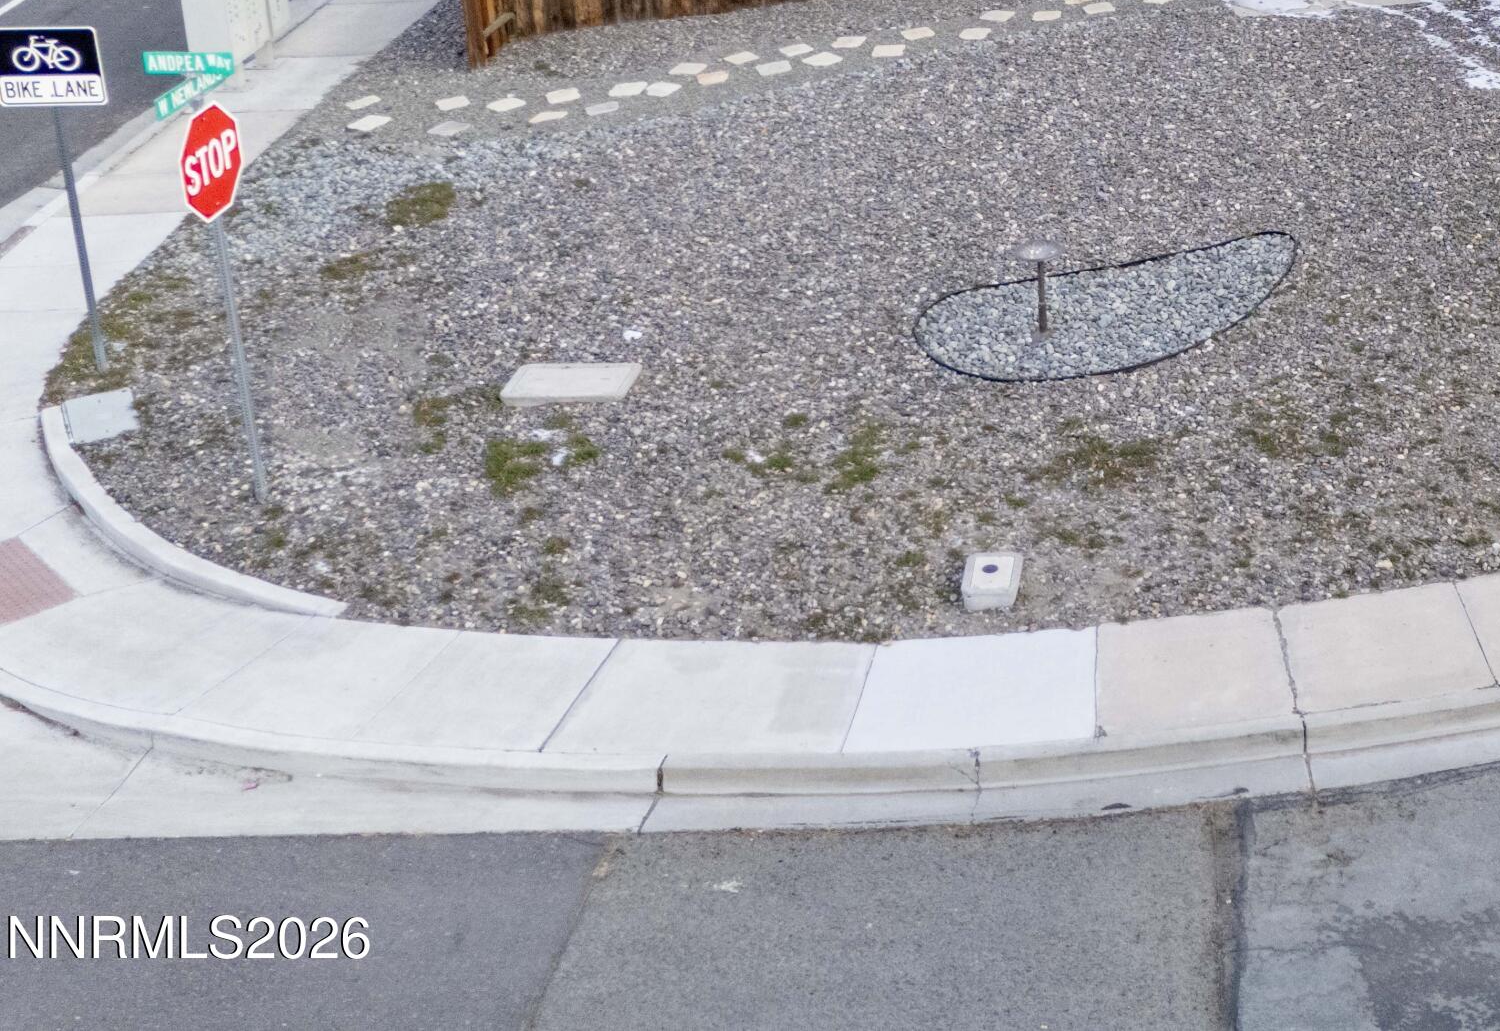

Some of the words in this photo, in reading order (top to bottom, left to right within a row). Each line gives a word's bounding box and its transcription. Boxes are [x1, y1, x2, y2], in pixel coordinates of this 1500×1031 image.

[147, 54, 205, 72] ANDREA
[206, 54, 232, 71] WAY
[4, 81, 43, 99] BIKE
[51, 80, 99, 98] LANE
[157, 97, 169, 117] W
[184, 128, 236, 197] STOP
